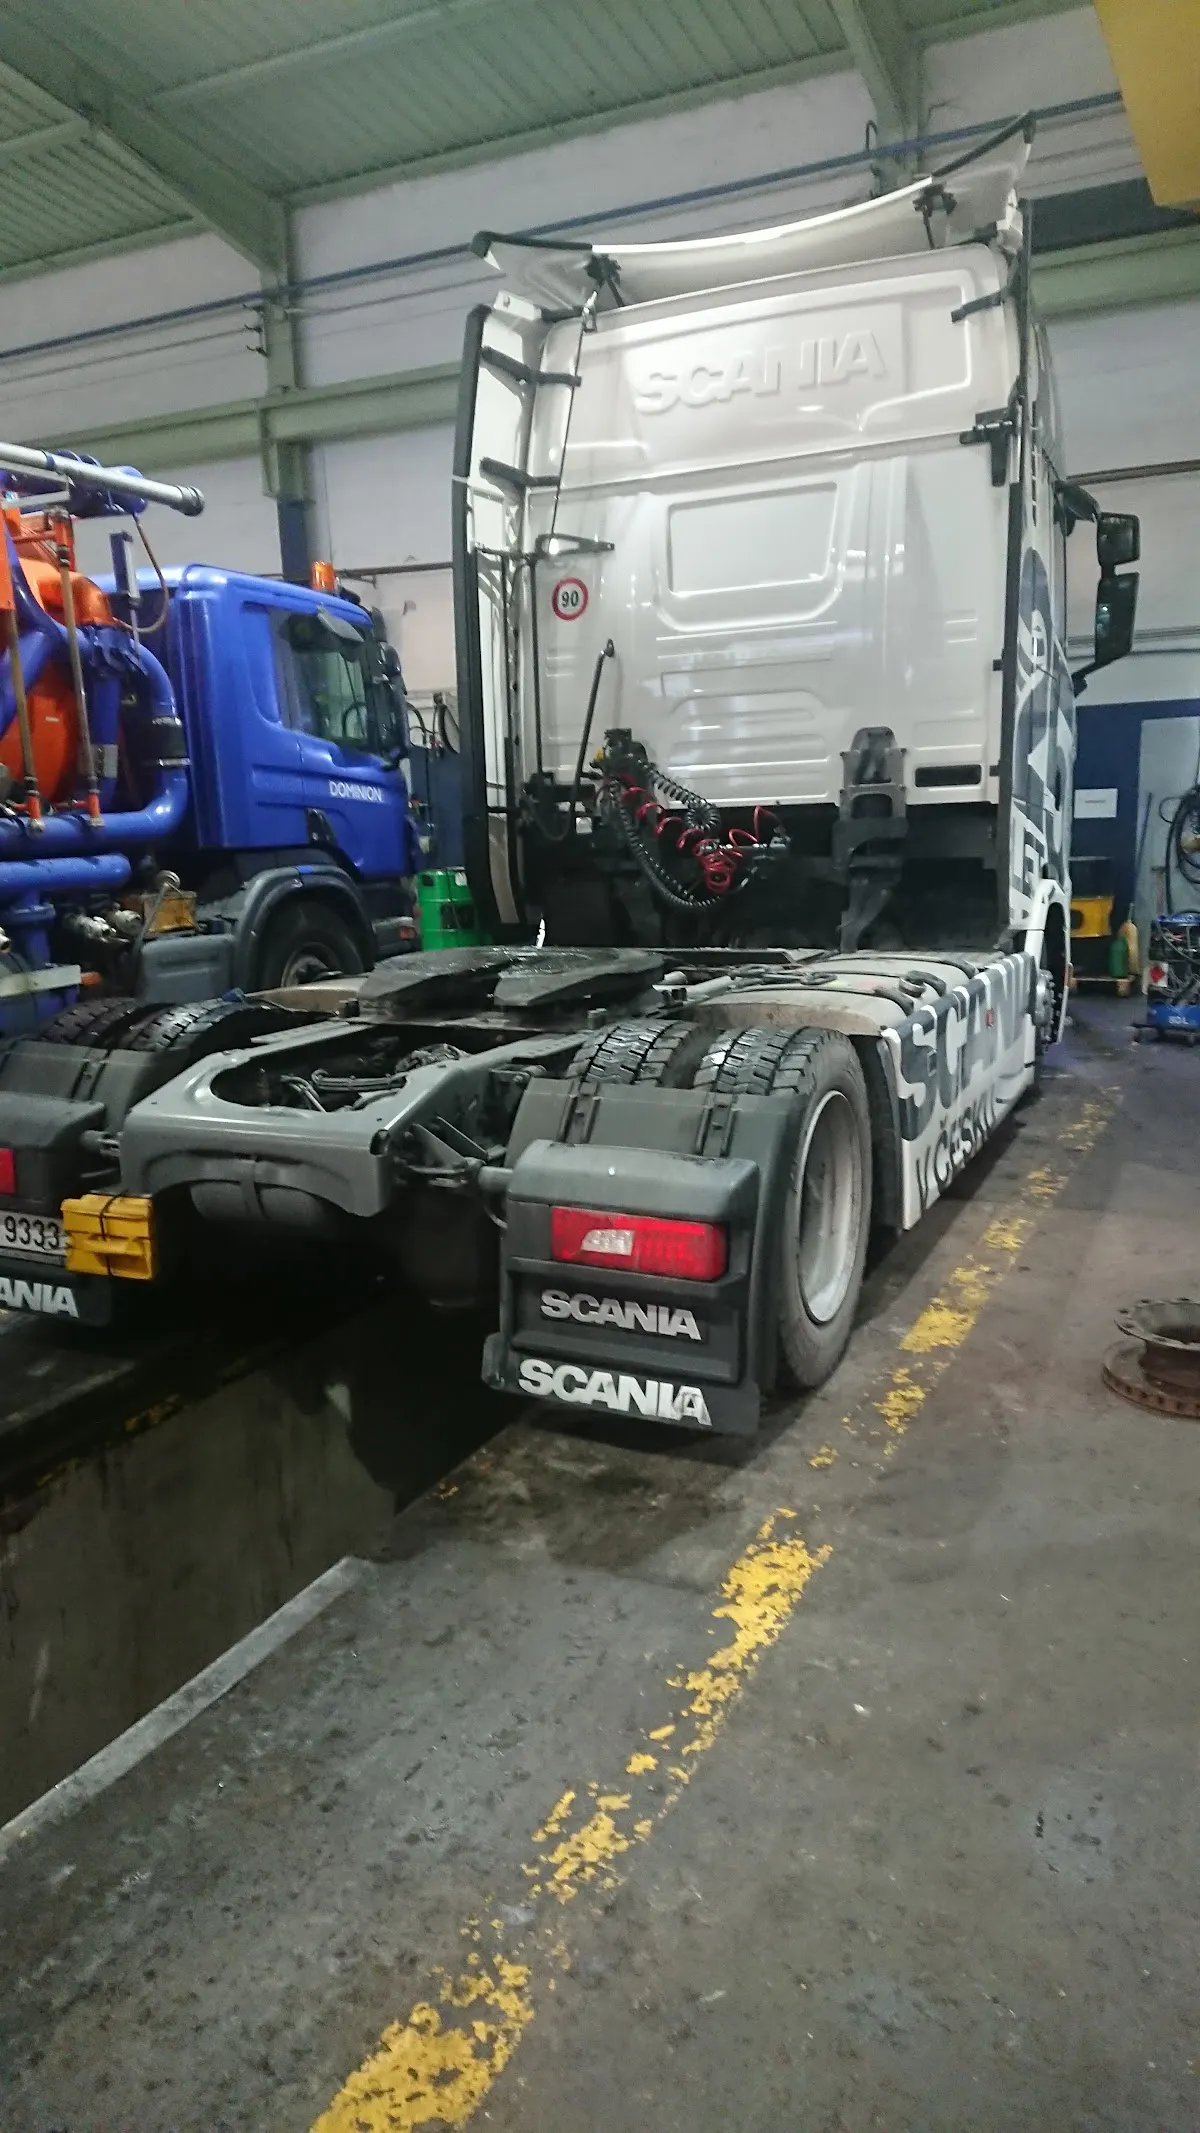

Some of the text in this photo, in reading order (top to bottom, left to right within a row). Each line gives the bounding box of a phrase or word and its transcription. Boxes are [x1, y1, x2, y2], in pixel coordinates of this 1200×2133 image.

[634, 330, 887, 416] SCANIA
[561, 590, 579, 608] 90
[329, 780, 383, 803] DOMINION
[4, 1215, 60, 1249] 9333
[540, 1289, 702, 1341] SCANIA
[518, 1358, 712, 1426] SCANIA
